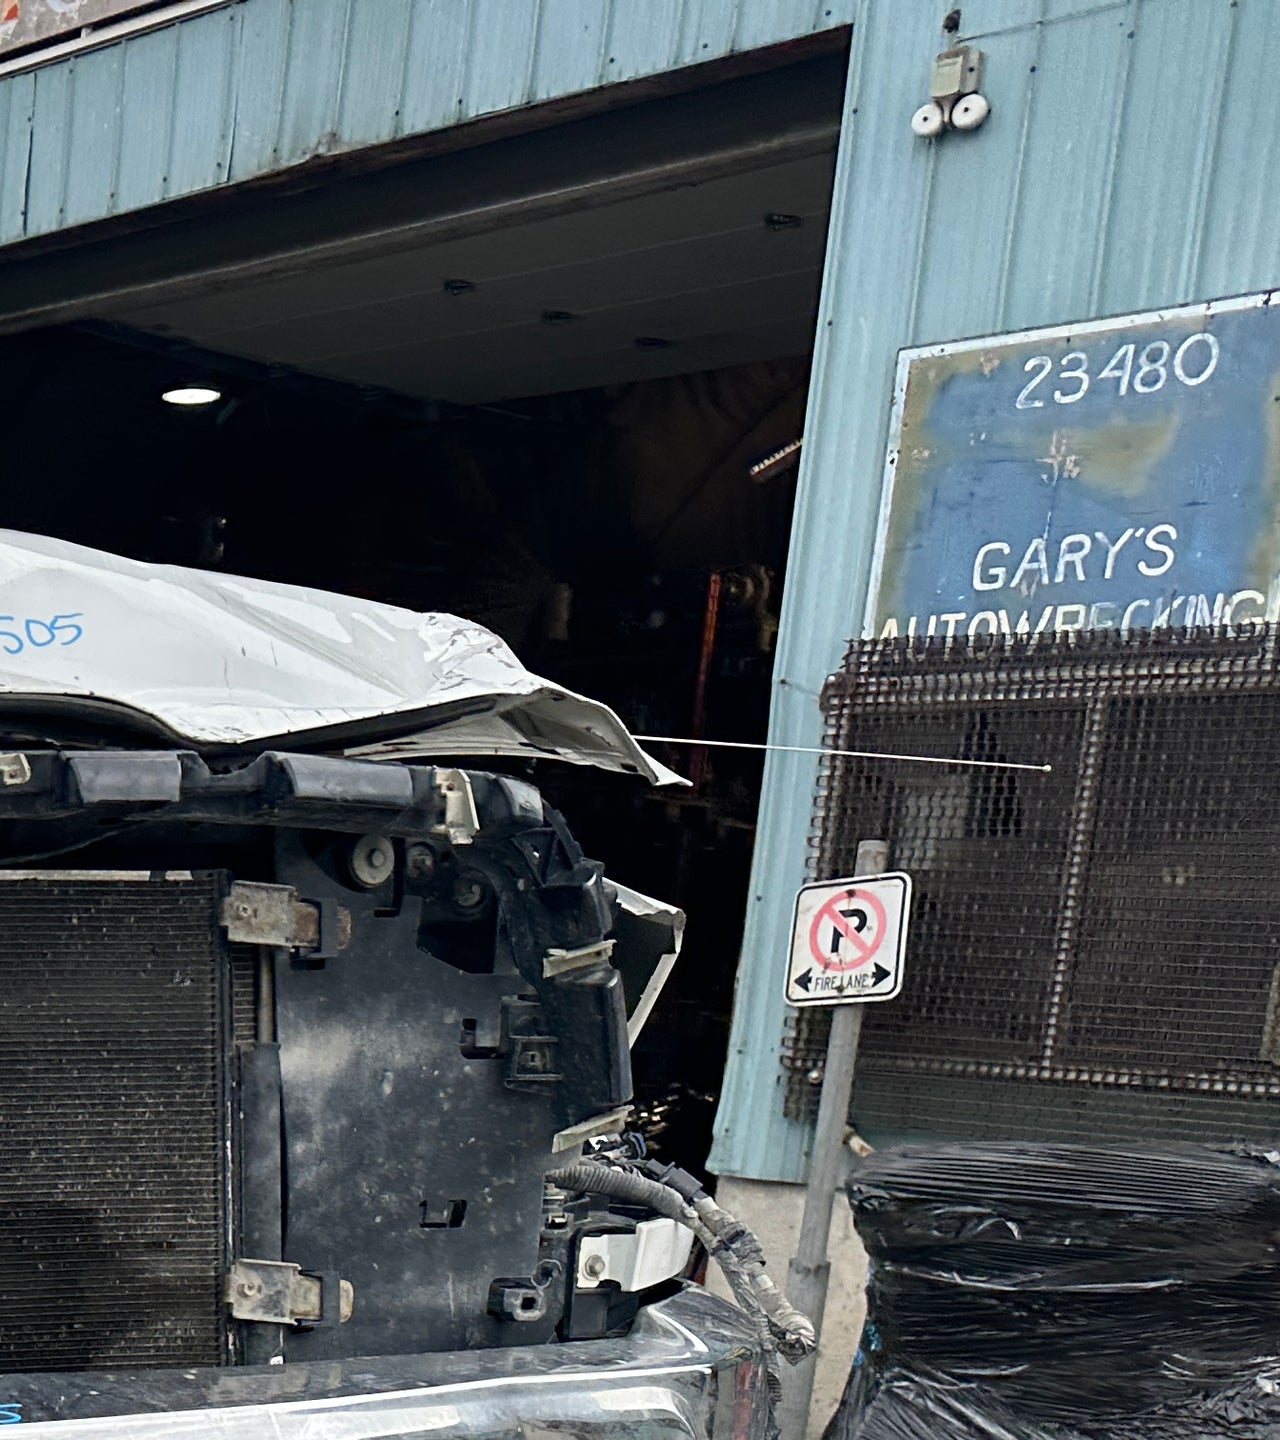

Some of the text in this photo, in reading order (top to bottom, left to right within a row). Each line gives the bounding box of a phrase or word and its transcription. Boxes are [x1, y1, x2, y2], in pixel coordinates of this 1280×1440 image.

[1015, 332, 1219, 410] 23480
[973, 524, 1178, 592] GARY'S
[814, 972, 870, 992] FIRE LANE
